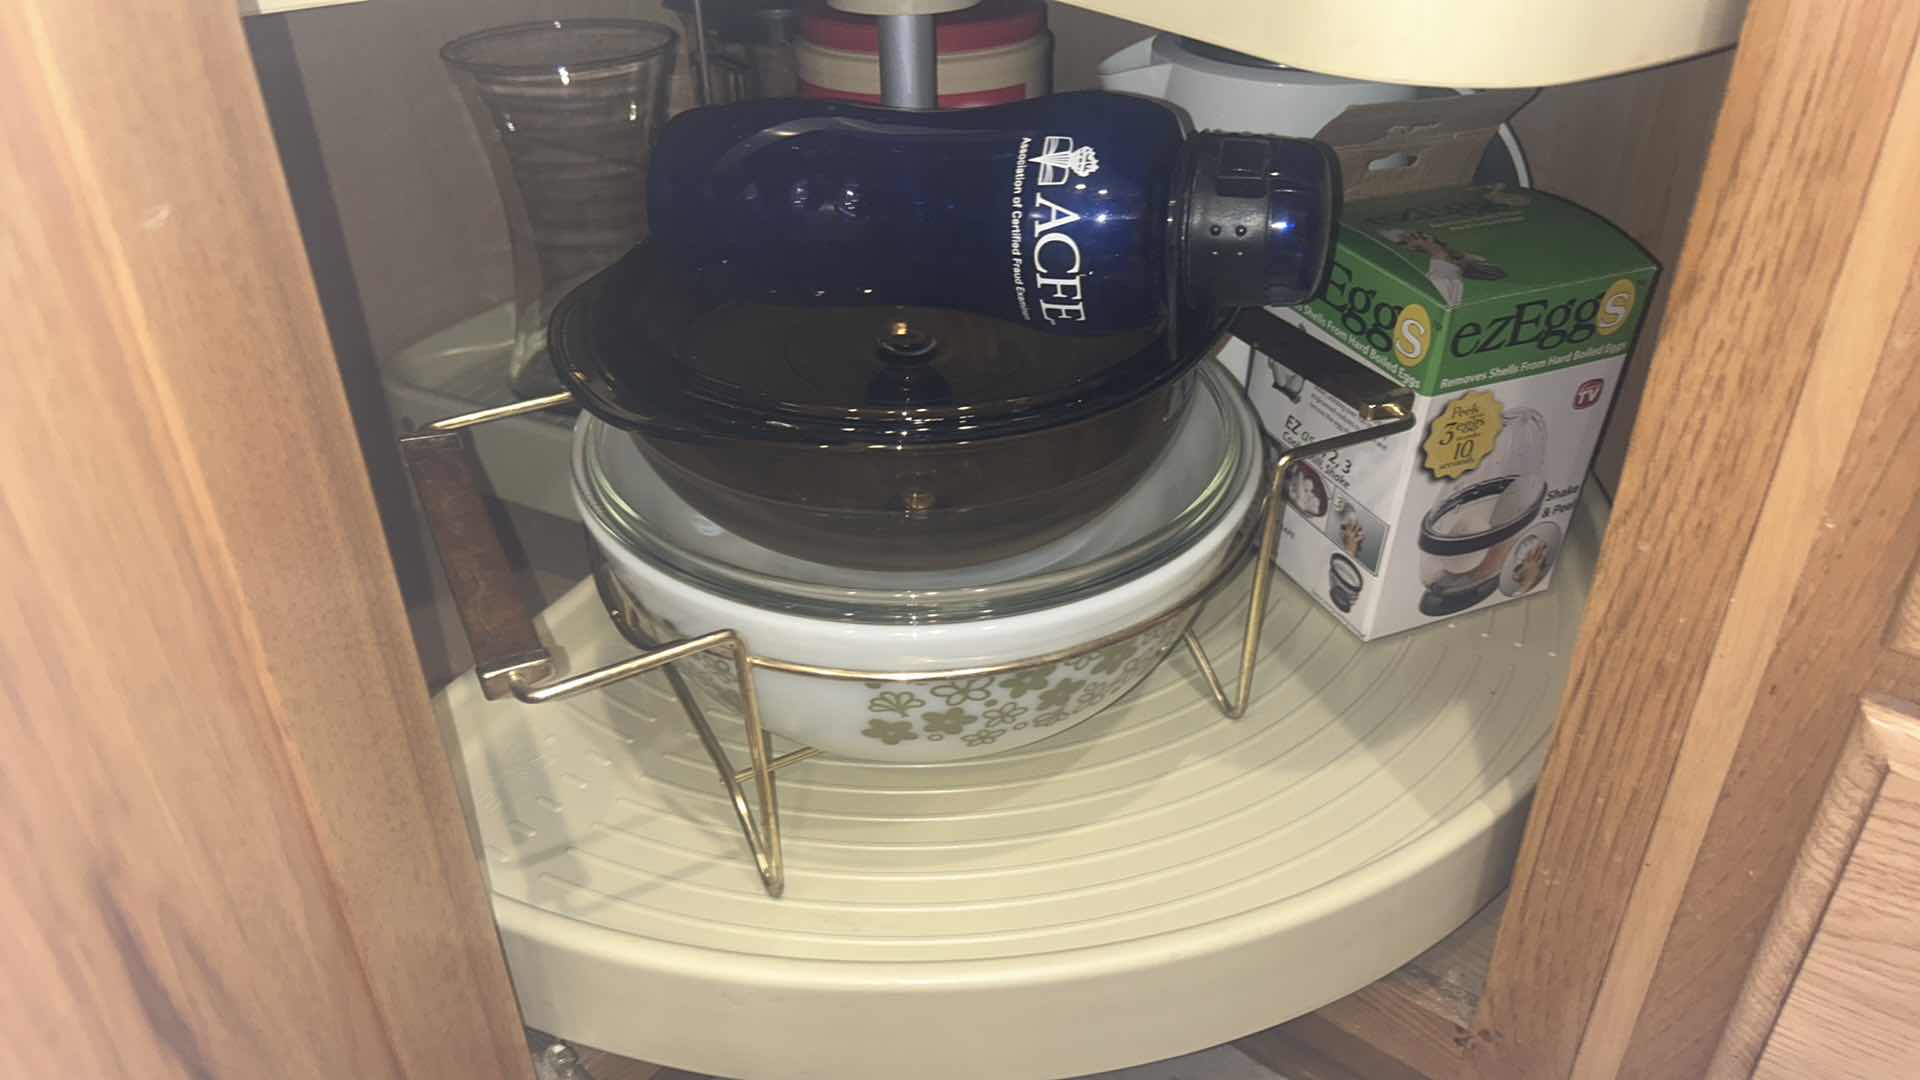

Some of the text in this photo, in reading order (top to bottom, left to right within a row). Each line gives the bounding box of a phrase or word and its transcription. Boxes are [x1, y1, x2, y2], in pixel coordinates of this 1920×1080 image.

[1012, 136, 1032, 195] Association
[1012, 196, 1023, 210] of
[1011, 210, 1023, 256] Certified
[1012, 257, 1025, 285] Fraud
[1033, 192, 1087, 322] ACFE
[1327, 321, 1349, 342] From
[1349, 335, 1369, 355] Hard
[1439, 372, 1488, 390] Removes
[1520, 359, 1547, 373] From
[1453, 439, 1475, 461] 10
